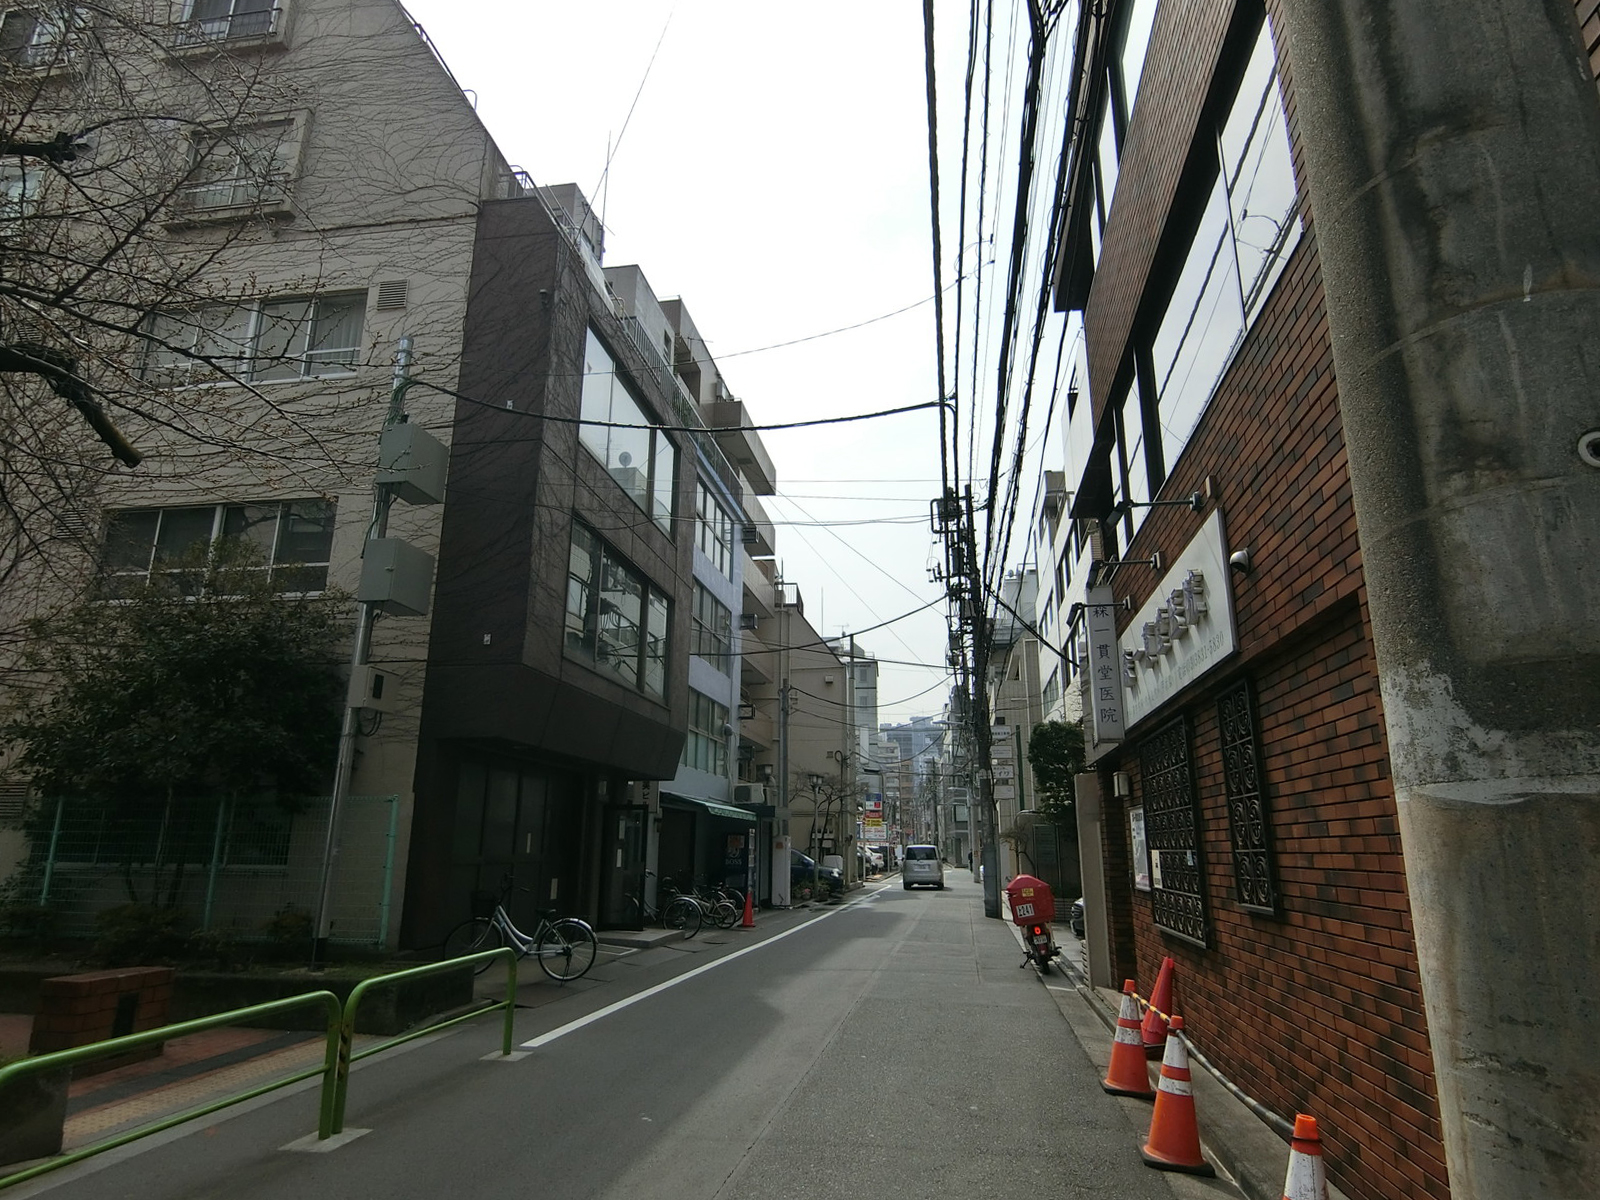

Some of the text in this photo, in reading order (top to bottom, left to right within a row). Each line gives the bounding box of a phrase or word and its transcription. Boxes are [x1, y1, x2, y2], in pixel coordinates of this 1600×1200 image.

[1093, 604, 1118, 723] 森一貫堂医院
